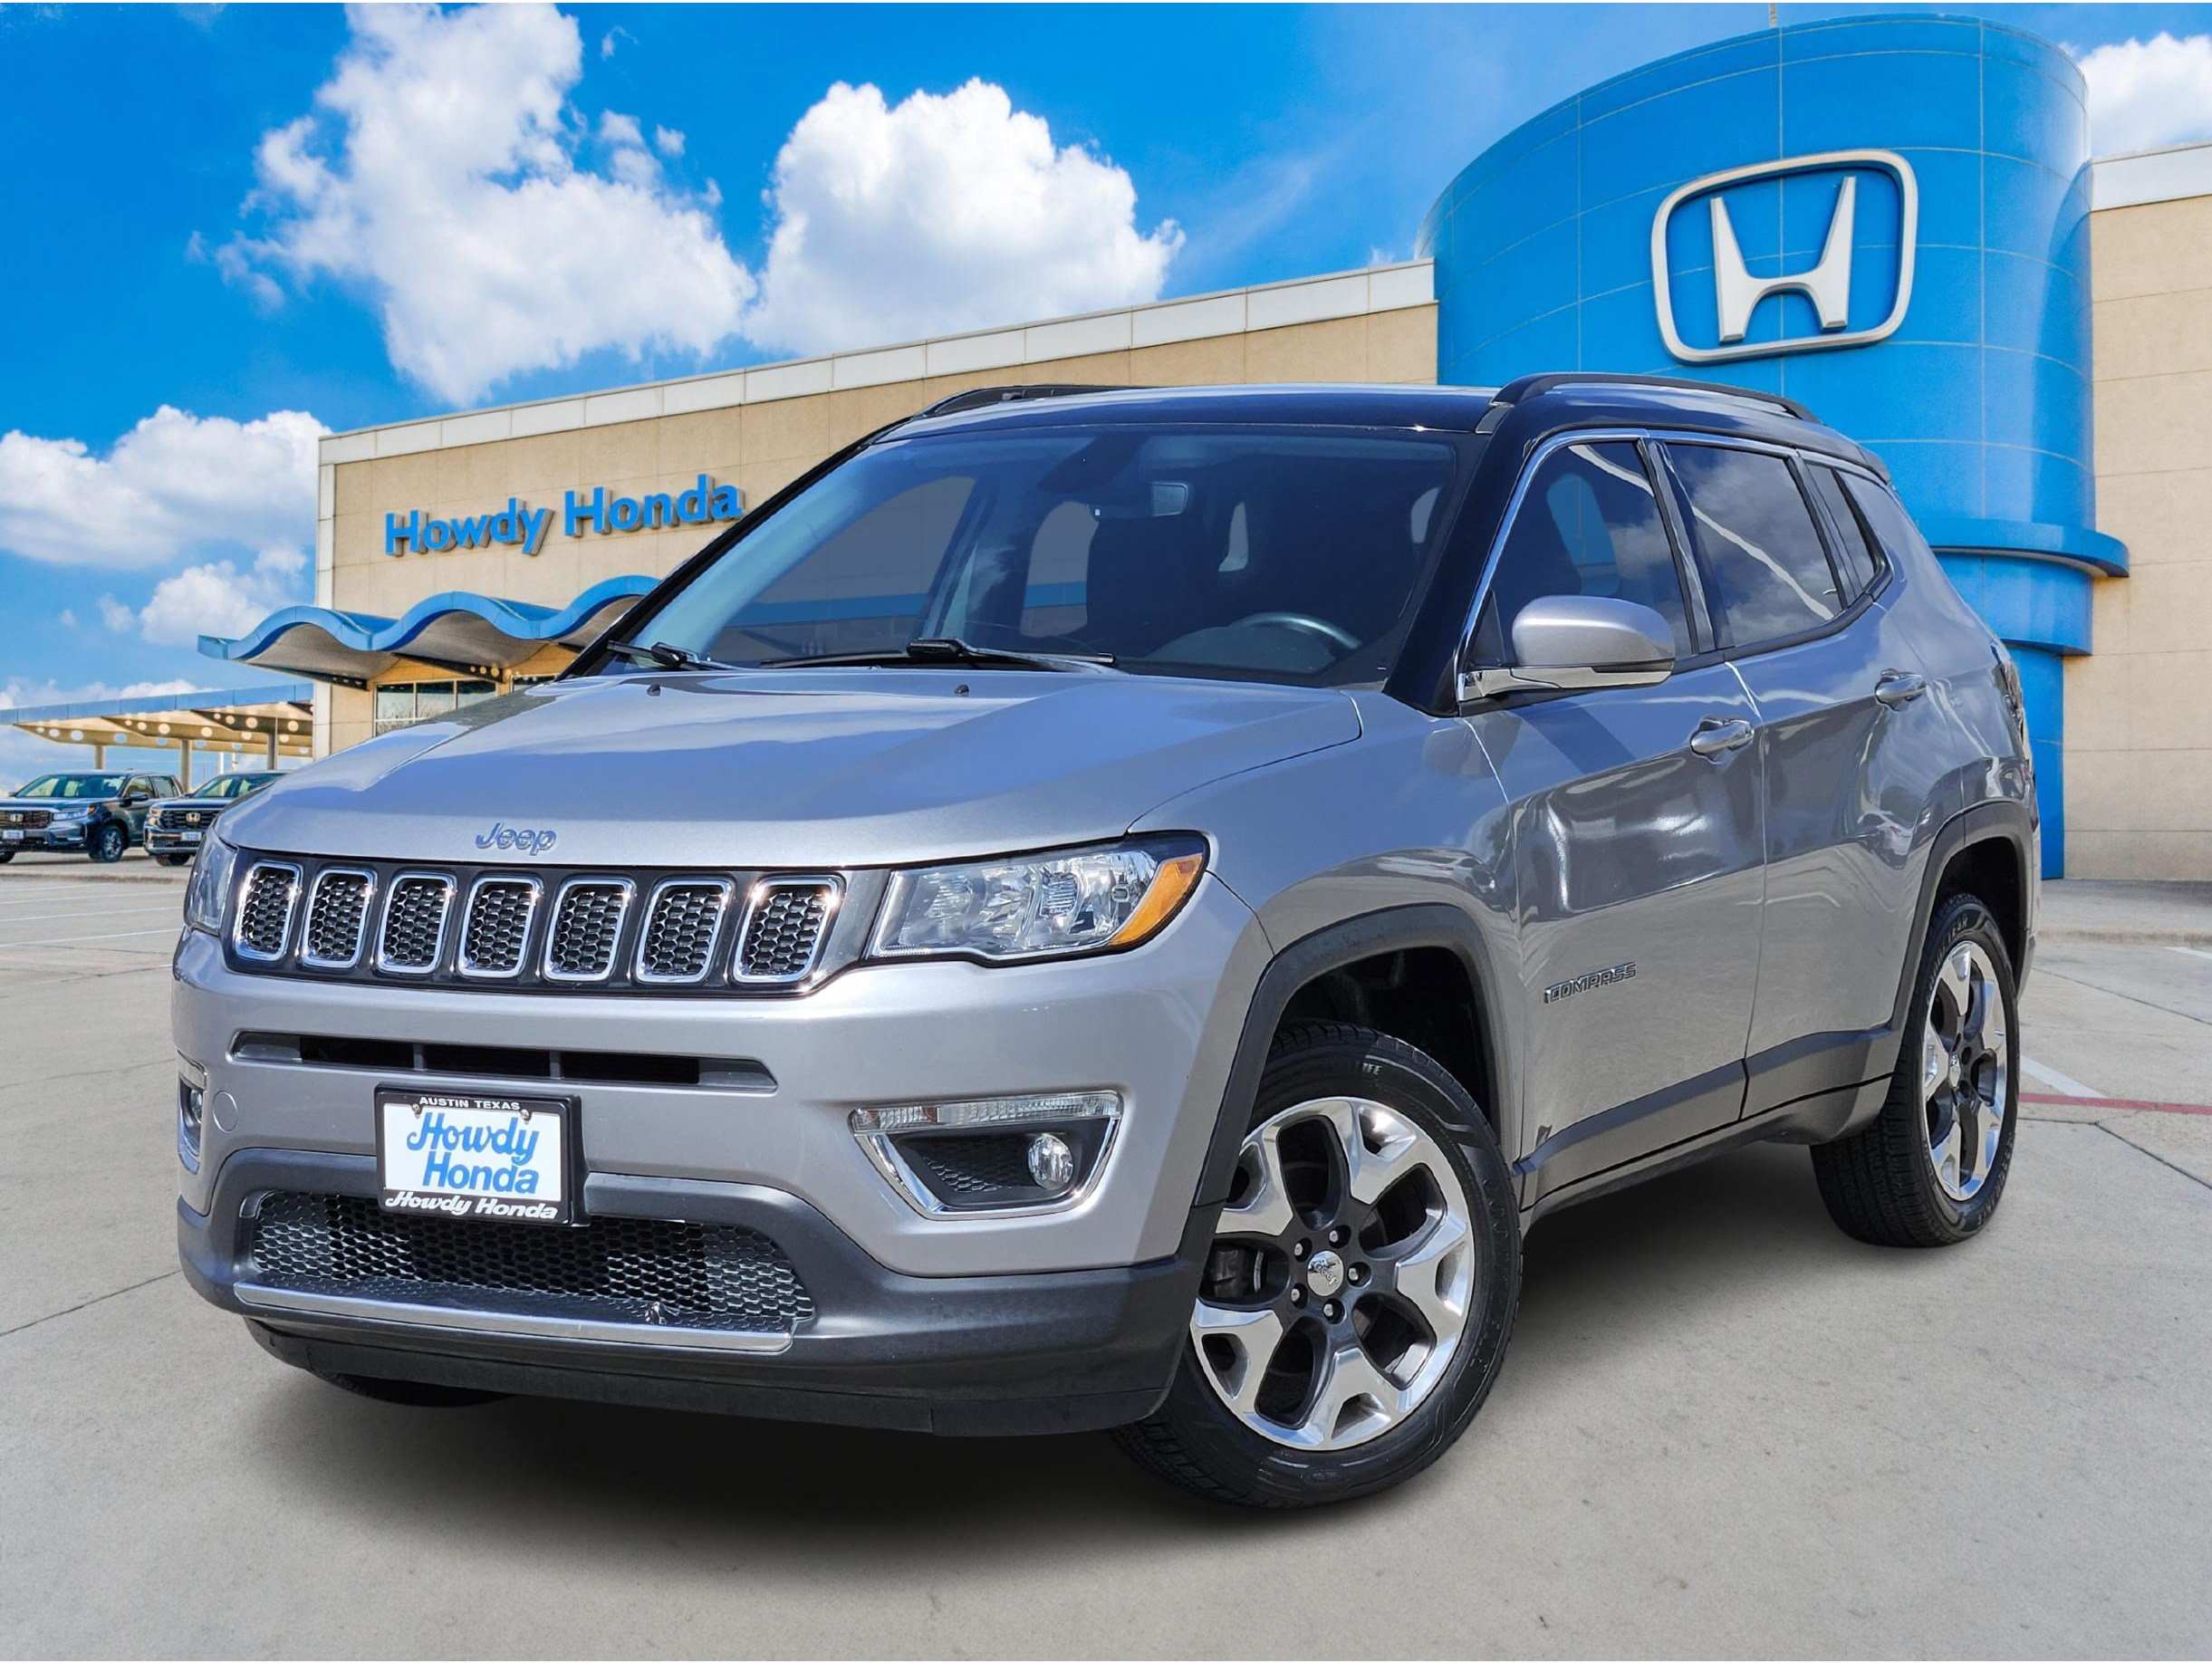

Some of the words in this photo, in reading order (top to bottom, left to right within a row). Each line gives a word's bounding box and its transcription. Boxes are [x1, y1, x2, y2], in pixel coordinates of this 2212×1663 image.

[385, 496, 554, 557] Howdy
[564, 474, 745, 538] Honda
[476, 822, 557, 856] Jeep
[1544, 961, 1637, 1004] COMPASS
[419, 1096, 469, 1108] AUSTIN
[474, 1100, 521, 1110] TEXAS
[407, 1112, 539, 1166] Howdy
[422, 1150, 540, 1195] Honda
[385, 1191, 472, 1216] Howdy
[475, 1197, 558, 1219] Honda
